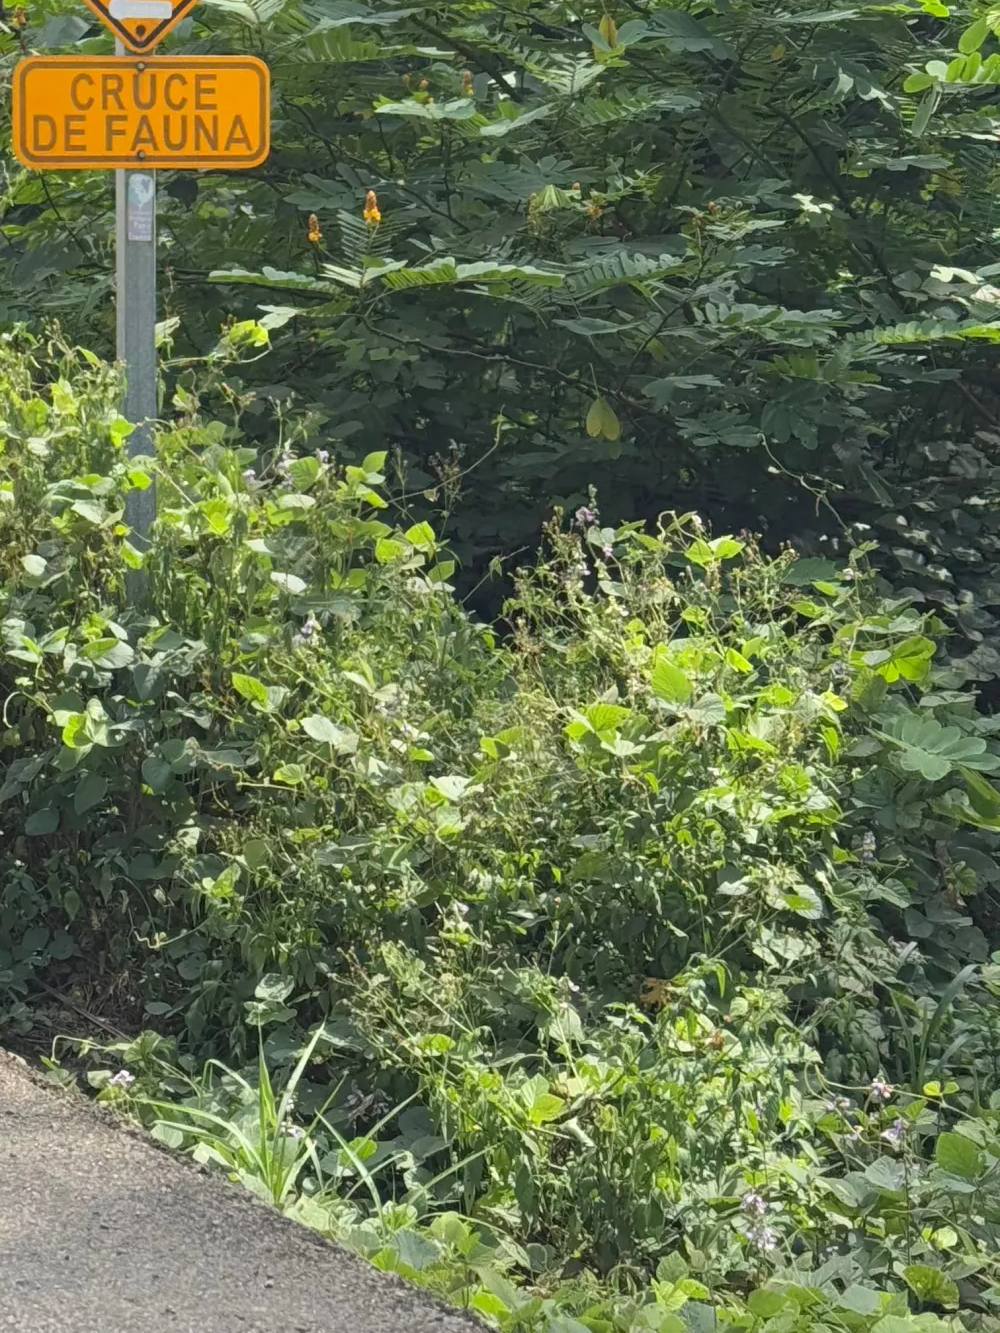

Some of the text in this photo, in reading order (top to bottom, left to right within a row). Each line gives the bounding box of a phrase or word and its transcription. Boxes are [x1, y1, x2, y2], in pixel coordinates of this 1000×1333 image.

[70, 73, 218, 112] CRUCE
[33, 114, 252, 152] DE FAUNA
